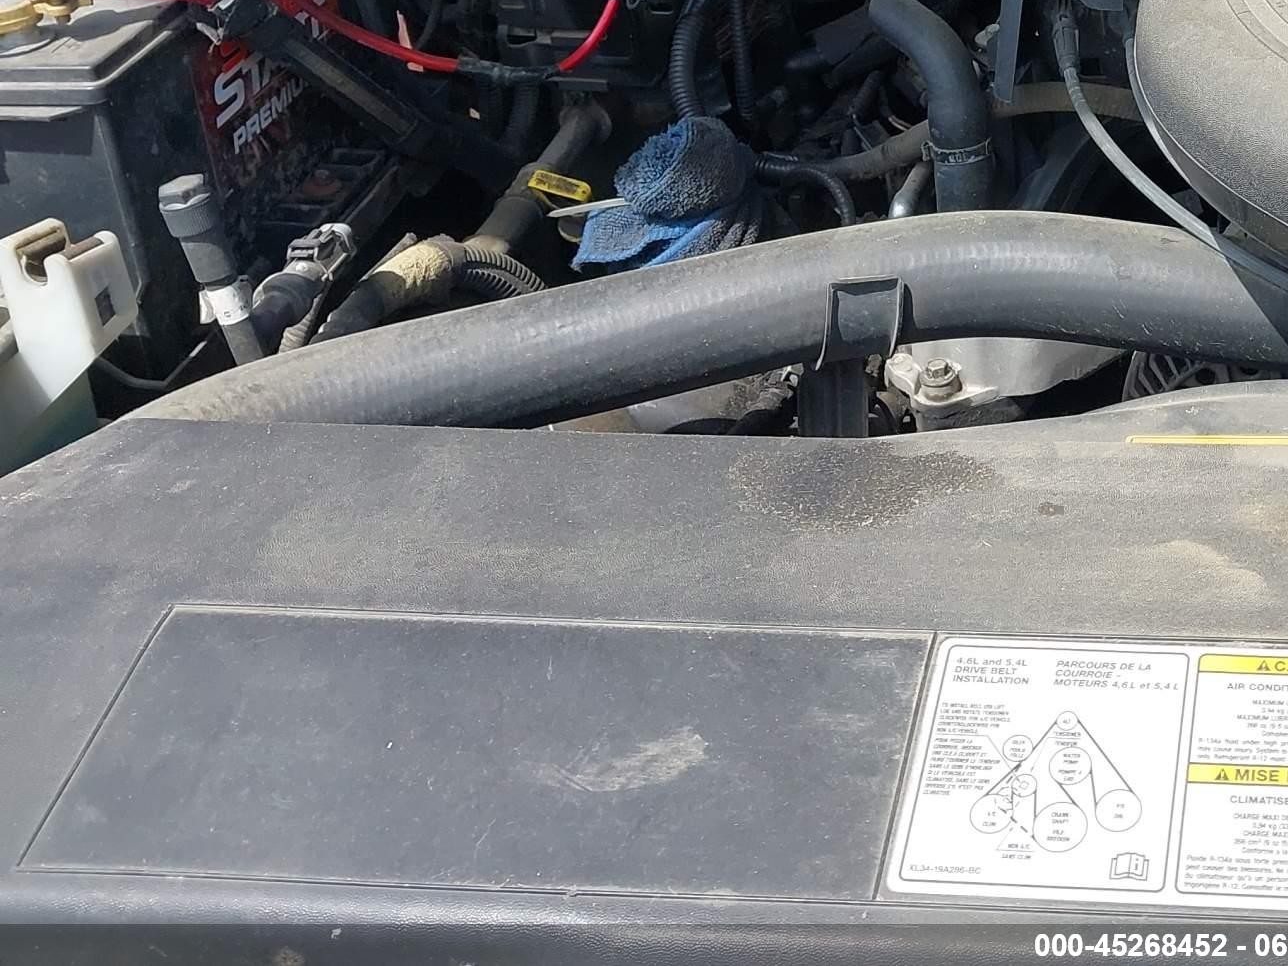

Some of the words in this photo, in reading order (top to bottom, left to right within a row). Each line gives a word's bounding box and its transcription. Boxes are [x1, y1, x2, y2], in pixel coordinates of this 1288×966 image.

[233, 77, 304, 155] PREMIU
[957, 657, 979, 665] 4.6L
[982, 658, 1002, 666] and
[1056, 660, 1117, 670] PARCOURS
[1120, 662, 1134, 670] DE
[954, 666, 987, 674] DRIVE
[991, 667, 1018, 675] BELT
[1055, 669, 1114, 679] COURROIE
[952, 675, 1030, 684] INSTALLATION
[1053, 678, 1108, 688] MOTEURS
[1140, 682, 1150, 690] et
[1227, 682, 1246, 690] AIR
[1234, 768, 1280, 782] MISE
